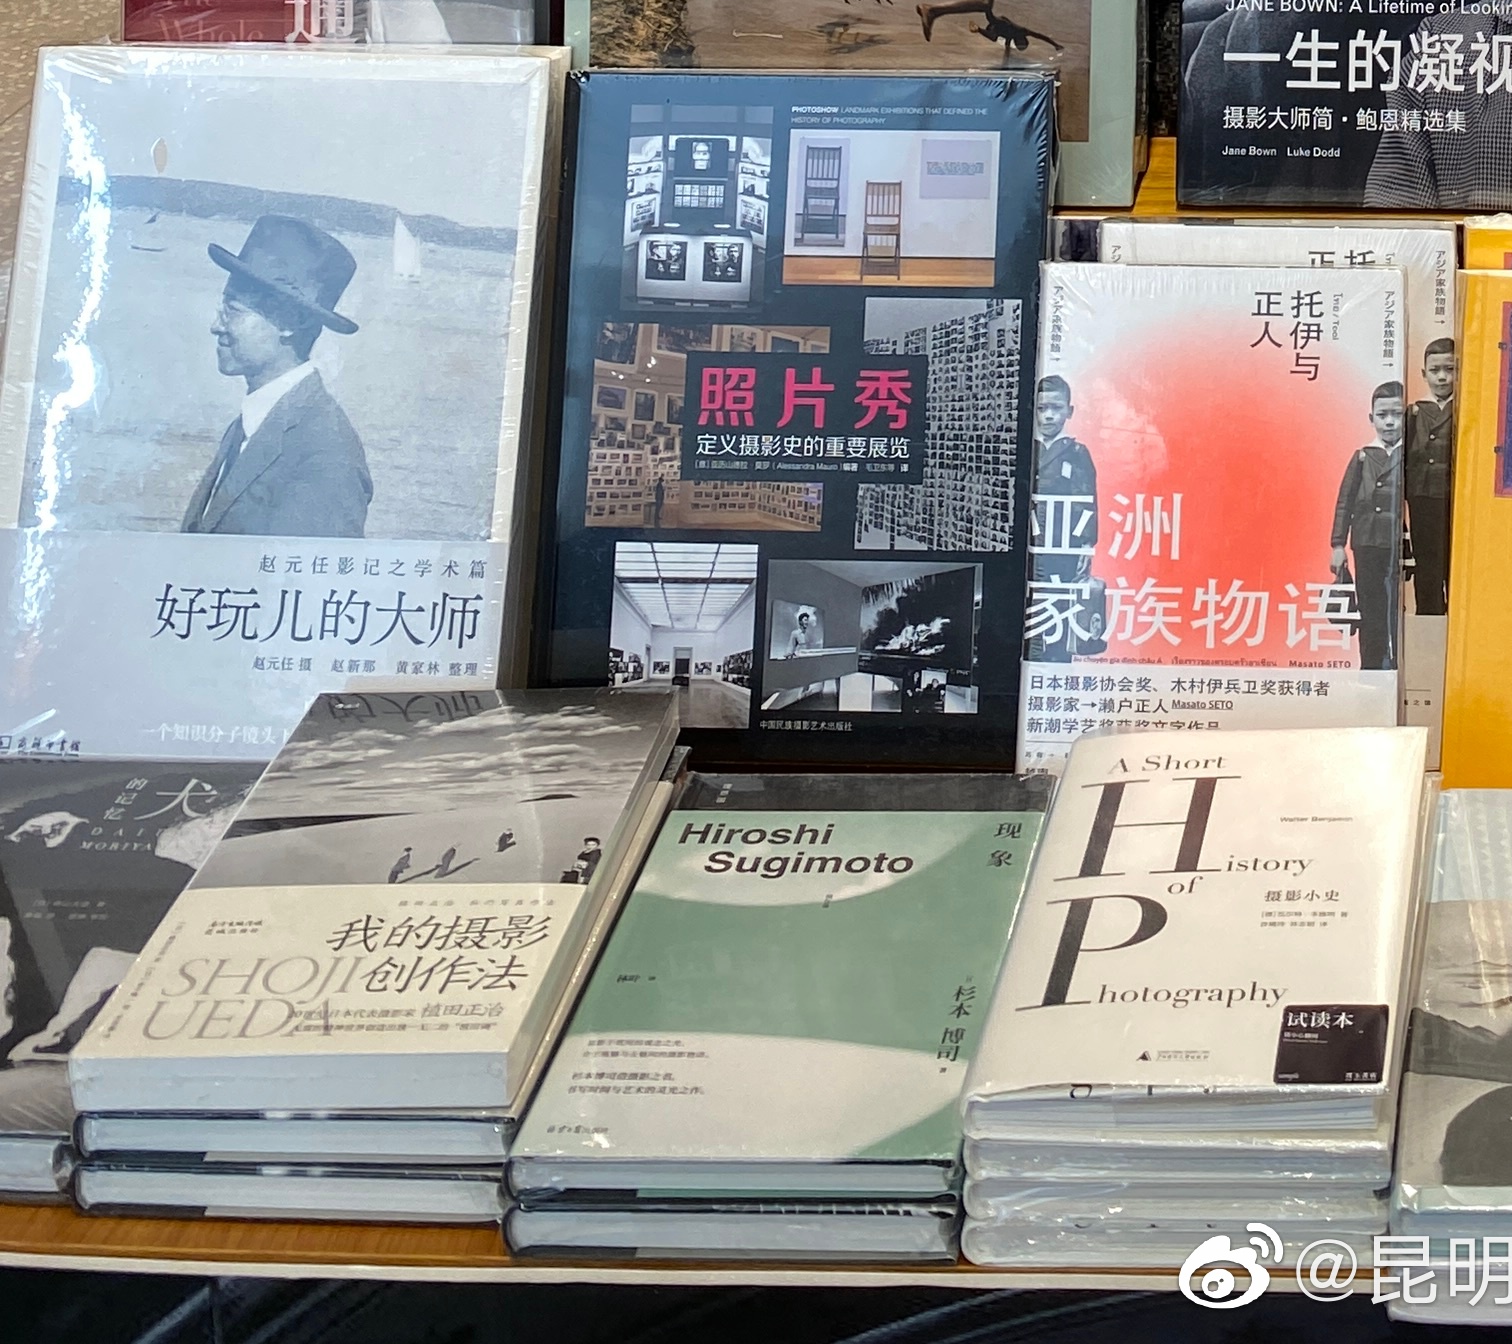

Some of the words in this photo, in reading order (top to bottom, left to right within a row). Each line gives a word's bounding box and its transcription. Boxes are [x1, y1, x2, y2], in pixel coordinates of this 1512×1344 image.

[1439, 0, 1457, 15] of
[791, 106, 839, 114] PHOTOSHOW
[1222, 106, 1467, 133] 摄影大师简·鲍恩精选集
[1222, 145, 1247, 158] Jane
[1249, 145, 1277, 158] Bown
[1287, 146, 1310, 158] Luke
[1312, 146, 1341, 159] Dodd
[1250, 291, 1283, 349] 正人
[1290, 290, 1324, 381] 托伊与
[698, 367, 913, 430] 照片秀
[696, 433, 912, 460] 定义摄影史的重要展览
[1029, 492, 1185, 561] 亚洲
[257, 554, 488, 580] 赵元任影记之学术篇
[150, 583, 485, 650] 好玩儿的大师
[1024, 578, 1362, 653] 家族物语
[252, 656, 294, 672] 赵元任
[331, 658, 376, 673] 赵新那
[395, 660, 441, 676] 黄家林
[448, 662, 479, 677] 整理
[1289, 659, 1325, 669] Masato
[1327, 659, 1351, 669] SETO
[1030, 675, 1330, 697] 日本摄影协会奖、木村伊兵卫奖获得者
[1172, 699, 1207, 710] Masato
[1208, 699, 1234, 711] SETO
[1106, 755, 1131, 776] A
[1140, 754, 1228, 773] Short
[103, 776, 149, 821] 的记忆
[677, 822, 836, 847] Hiroshi
[984, 821, 1024, 869] 现象
[704, 850, 915, 880] Sugimoto
[1166, 875, 1204, 896] of
[1264, 889, 1340, 903] 摄影小史
[326, 914, 552, 953] 我的摄影
[1016, 894, 1290, 1012] Photography
[163, 955, 367, 1002] SHOJI
[361, 955, 529, 995] 创作法
[142, 996, 335, 1042] UEDA
[420, 1001, 506, 1020] 植田正治
[936, 984, 977, 1063] 杉本博司
[1286, 1010, 1354, 1029] 试读本
